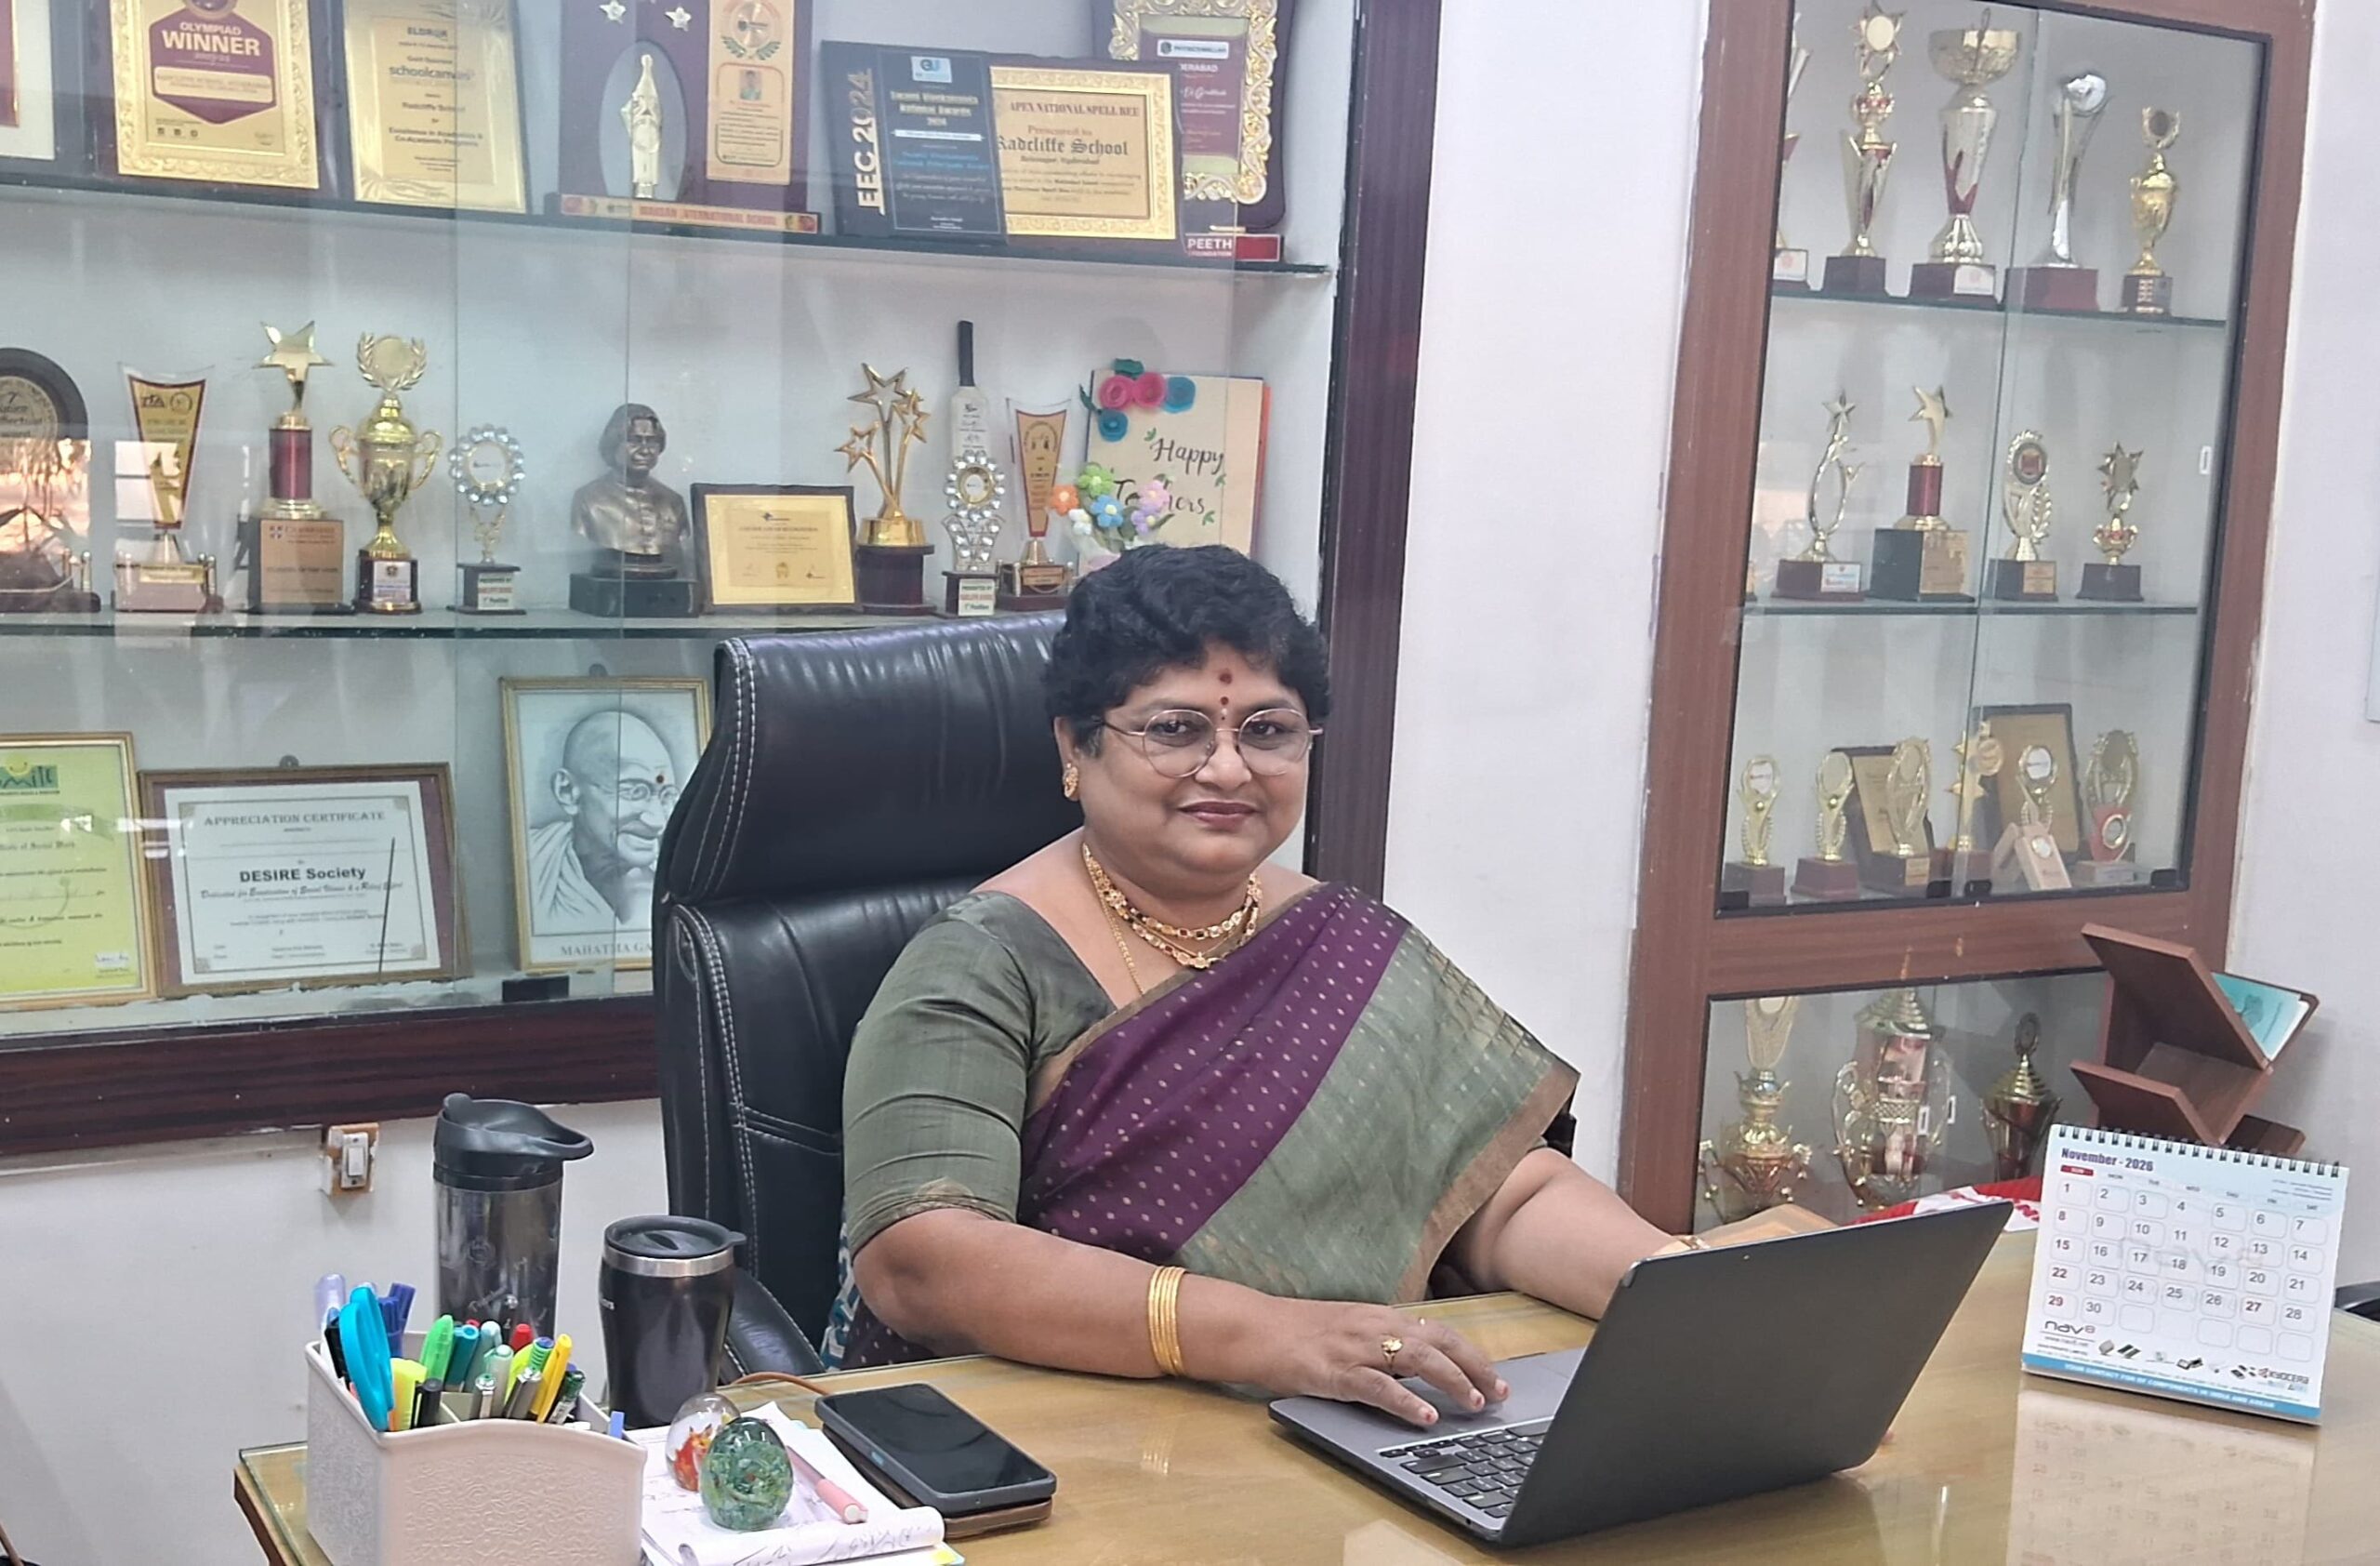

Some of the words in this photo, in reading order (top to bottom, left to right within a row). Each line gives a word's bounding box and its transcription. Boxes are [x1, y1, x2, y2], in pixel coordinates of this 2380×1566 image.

[179, 21, 242, 36] OLYMPIAD
[162, 30, 261, 57] WINNER
[848, 68, 877, 143] 2024
[1011, 101, 1035, 113] APEX
[1037, 102, 1084, 114] NATIONAL
[1087, 105, 1118, 116] SPELL
[1119, 106, 1139, 117] BEE
[1071, 139, 1129, 157] School
[853, 151, 879, 207] EEC
[1187, 238, 1233, 249] PEETH
[1149, 438, 1224, 476] Happy
[205, 815, 299, 826] APPRECIATION
[303, 811, 385, 823] CERTIFICATE
[240, 869, 301, 883] DESIRE
[306, 867, 366, 882] Society
[2061, 1148, 2118, 1166] November
[2125, 1157, 2154, 1172] 2026
[2064, 1183, 2070, 1193] 1
[2100, 1188, 2109, 1200] 2
[2138, 1194, 2148, 1206] 3
[2176, 1201, 2185, 1211] 4
[2215, 1207, 2225, 1217] 5
[2256, 1214, 2266, 1225] 6
[2295, 1220, 2304, 1230] 7
[2057, 1210, 2067, 1221] 8
[2096, 1216, 2104, 1228] 9
[2135, 1224, 2150, 1235] 10
[2174, 1229, 2187, 1241] 11
[2214, 1237, 2228, 1249] 12
[2253, 1243, 2268, 1254] 13
[2294, 1250, 2307, 1261] 14
[2056, 1239, 2070, 1250] 15
[2094, 1245, 2109, 1256] 16
[2134, 1252, 2148, 1263] 17
[2172, 1258, 2187, 1270] 18
[2211, 1265, 2226, 1277] 19
[2249, 1272, 2266, 1284] 20
[2289, 1279, 2305, 1290] 21
[2048, 1294, 2064, 1307] 29
[2085, 1302, 2102, 1313] 30
[2052, 1267, 2068, 1279] 22
[2090, 1273, 2106, 1285] 23
[2127, 1281, 2144, 1292] 24
[2166, 1287, 2183, 1299] 25
[2205, 1294, 2222, 1306] 26
[2245, 1301, 2262, 1312] 27
[2285, 1307, 2302, 1320] 28
